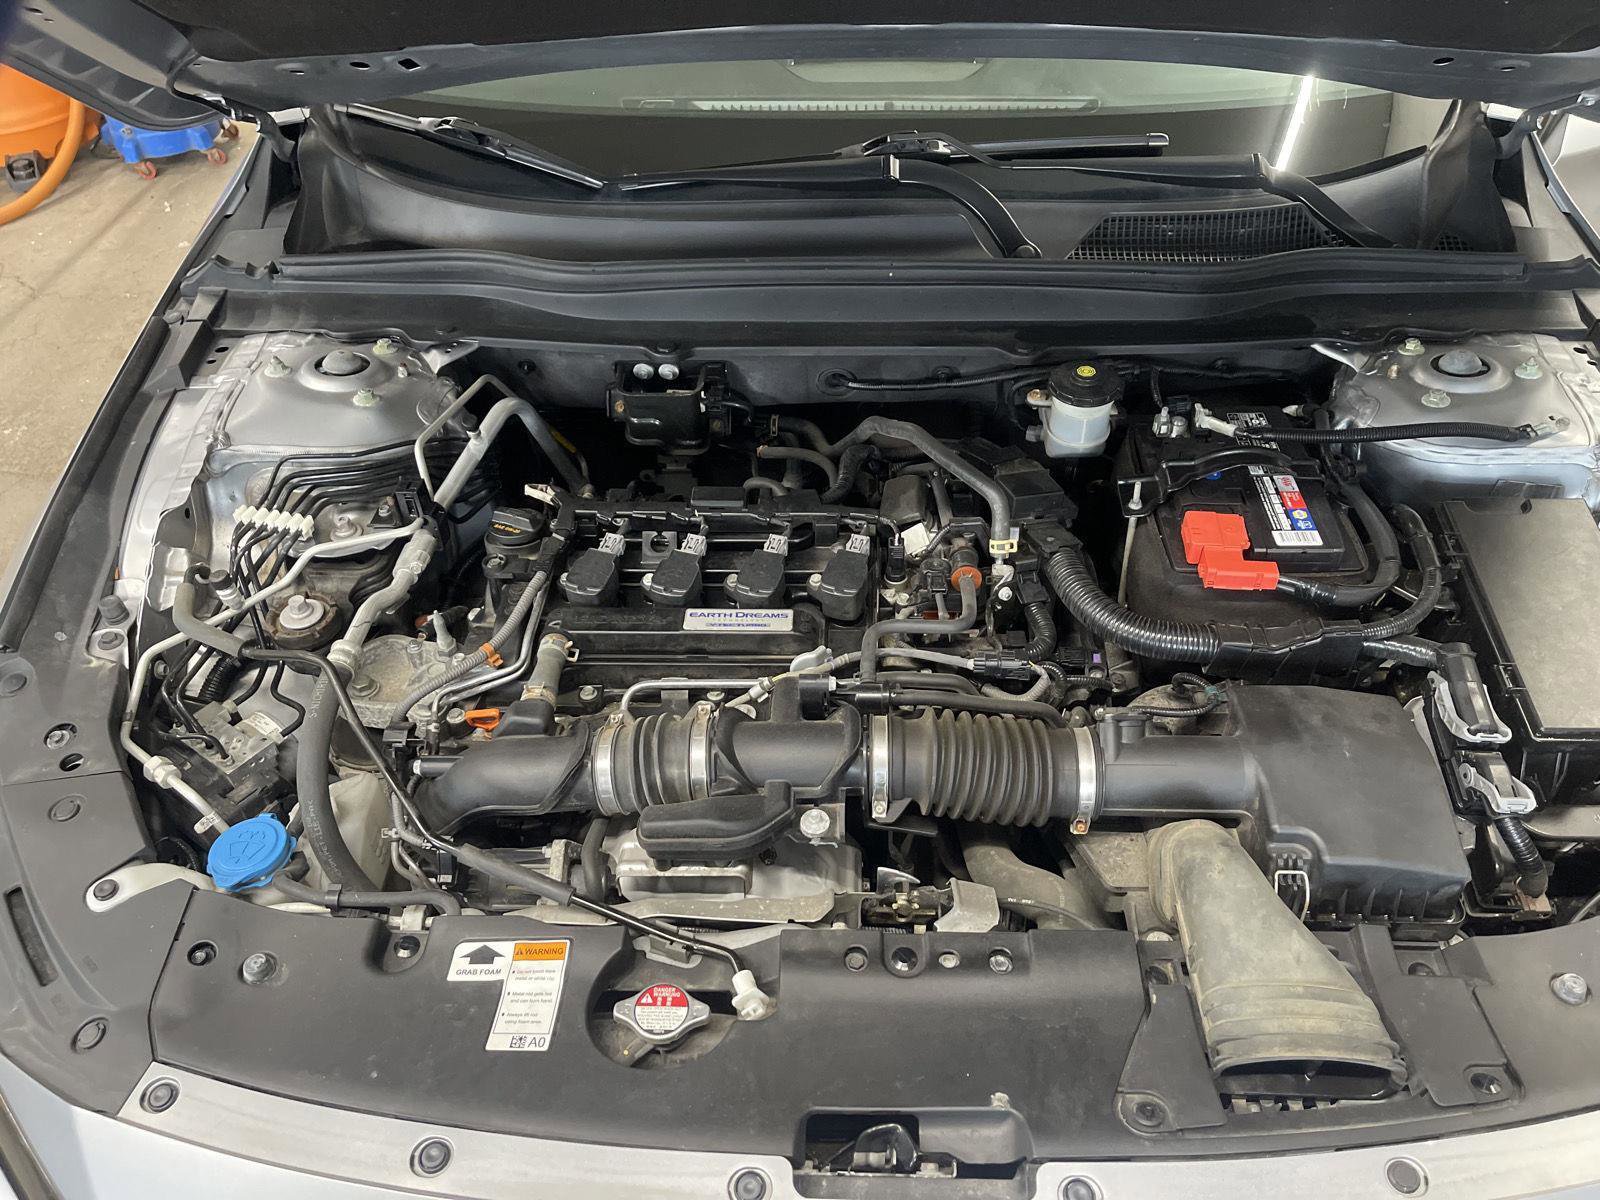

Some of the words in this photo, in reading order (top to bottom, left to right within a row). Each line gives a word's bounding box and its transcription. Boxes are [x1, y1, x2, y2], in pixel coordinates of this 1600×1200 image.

[689, 611, 733, 619] EARTH
[735, 611, 789, 619] DREAMS
[525, 947, 564, 955] WARNING
[456, 968, 477, 976] GRAB
[479, 968, 502, 976] FOAM
[527, 1037, 546, 1049] A0
